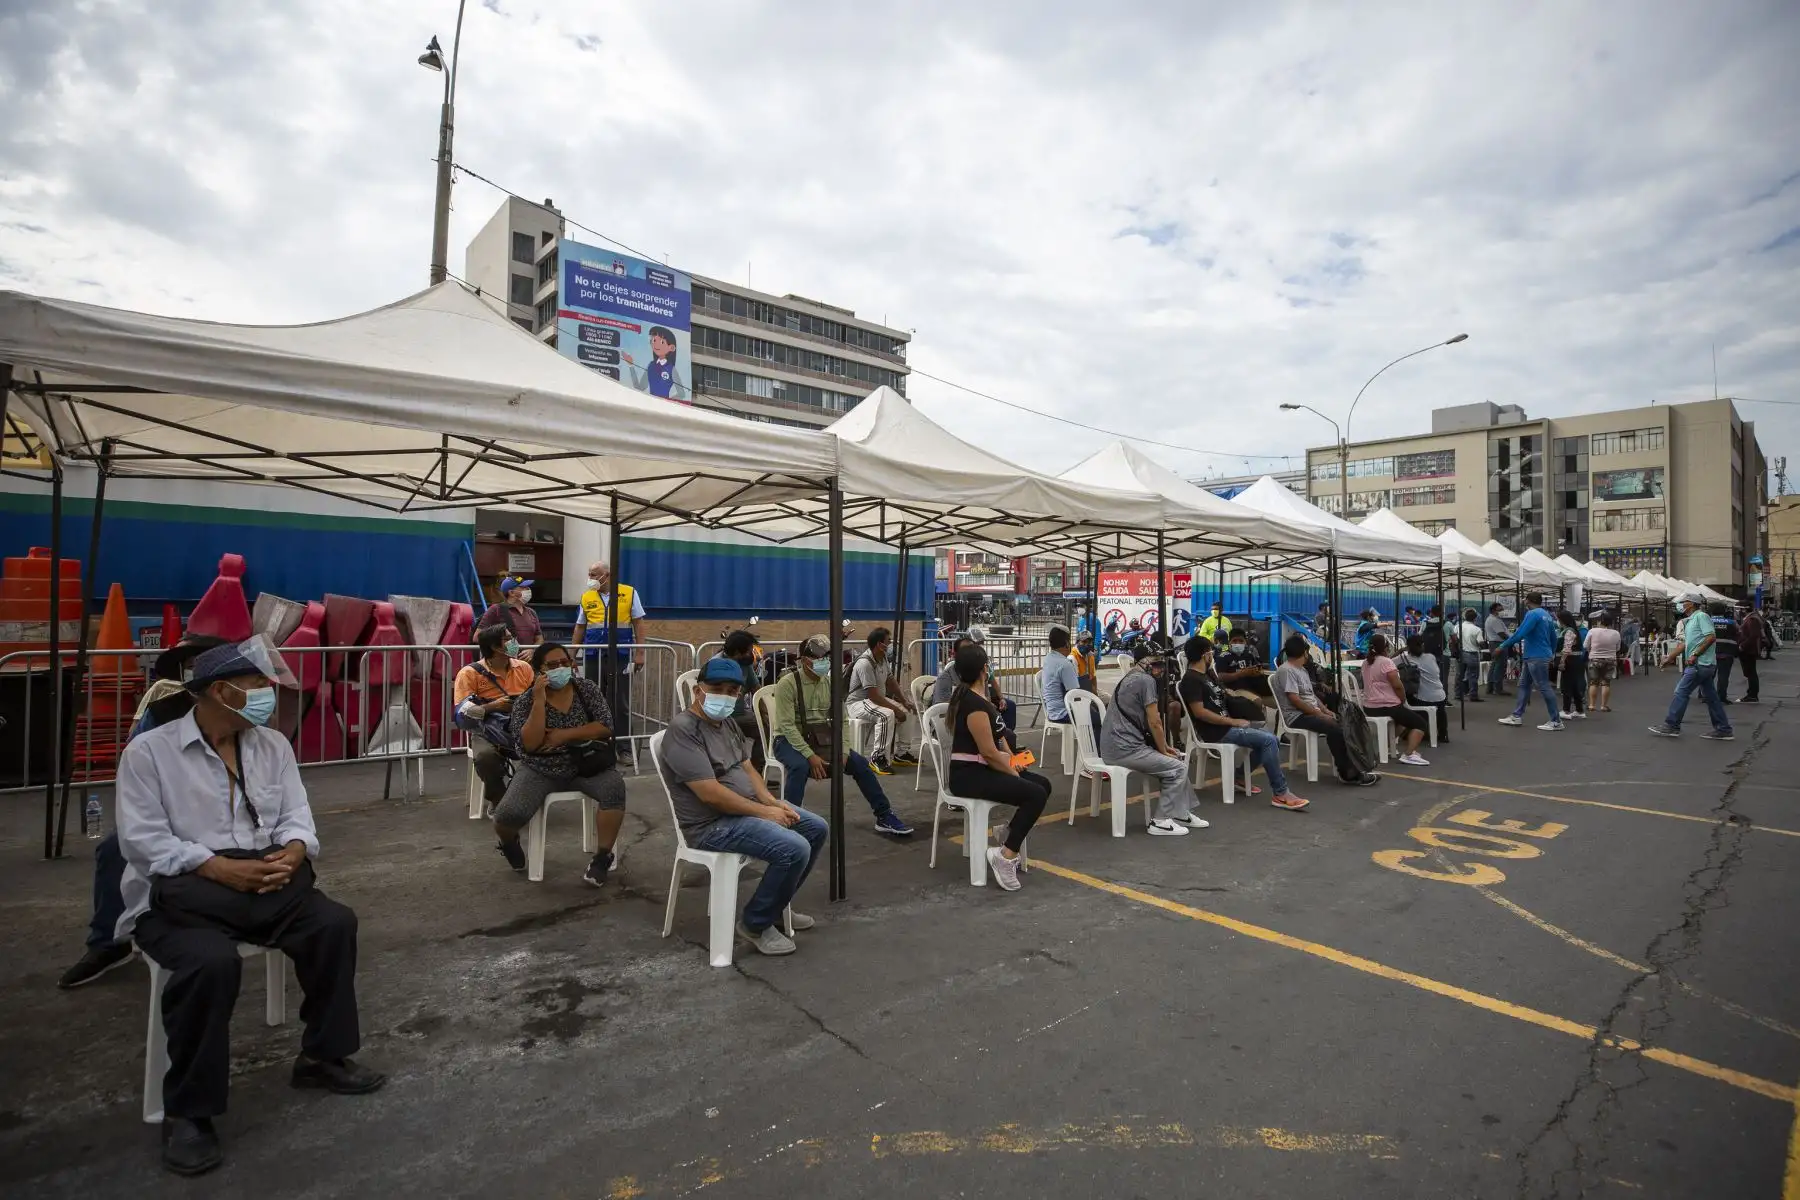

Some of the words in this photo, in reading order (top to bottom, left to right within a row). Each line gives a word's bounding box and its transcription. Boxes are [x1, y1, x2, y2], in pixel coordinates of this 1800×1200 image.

[574, 275, 589, 287] No
[591, 279, 601, 289] te
[603, 282, 629, 296] dejes
[630, 290, 679, 308] sorprender
[580, 289, 597, 299] por
[599, 291, 614, 303] los
[616, 296, 674, 318] tramitadores
[1103, 587, 1129, 595] SALIDA
